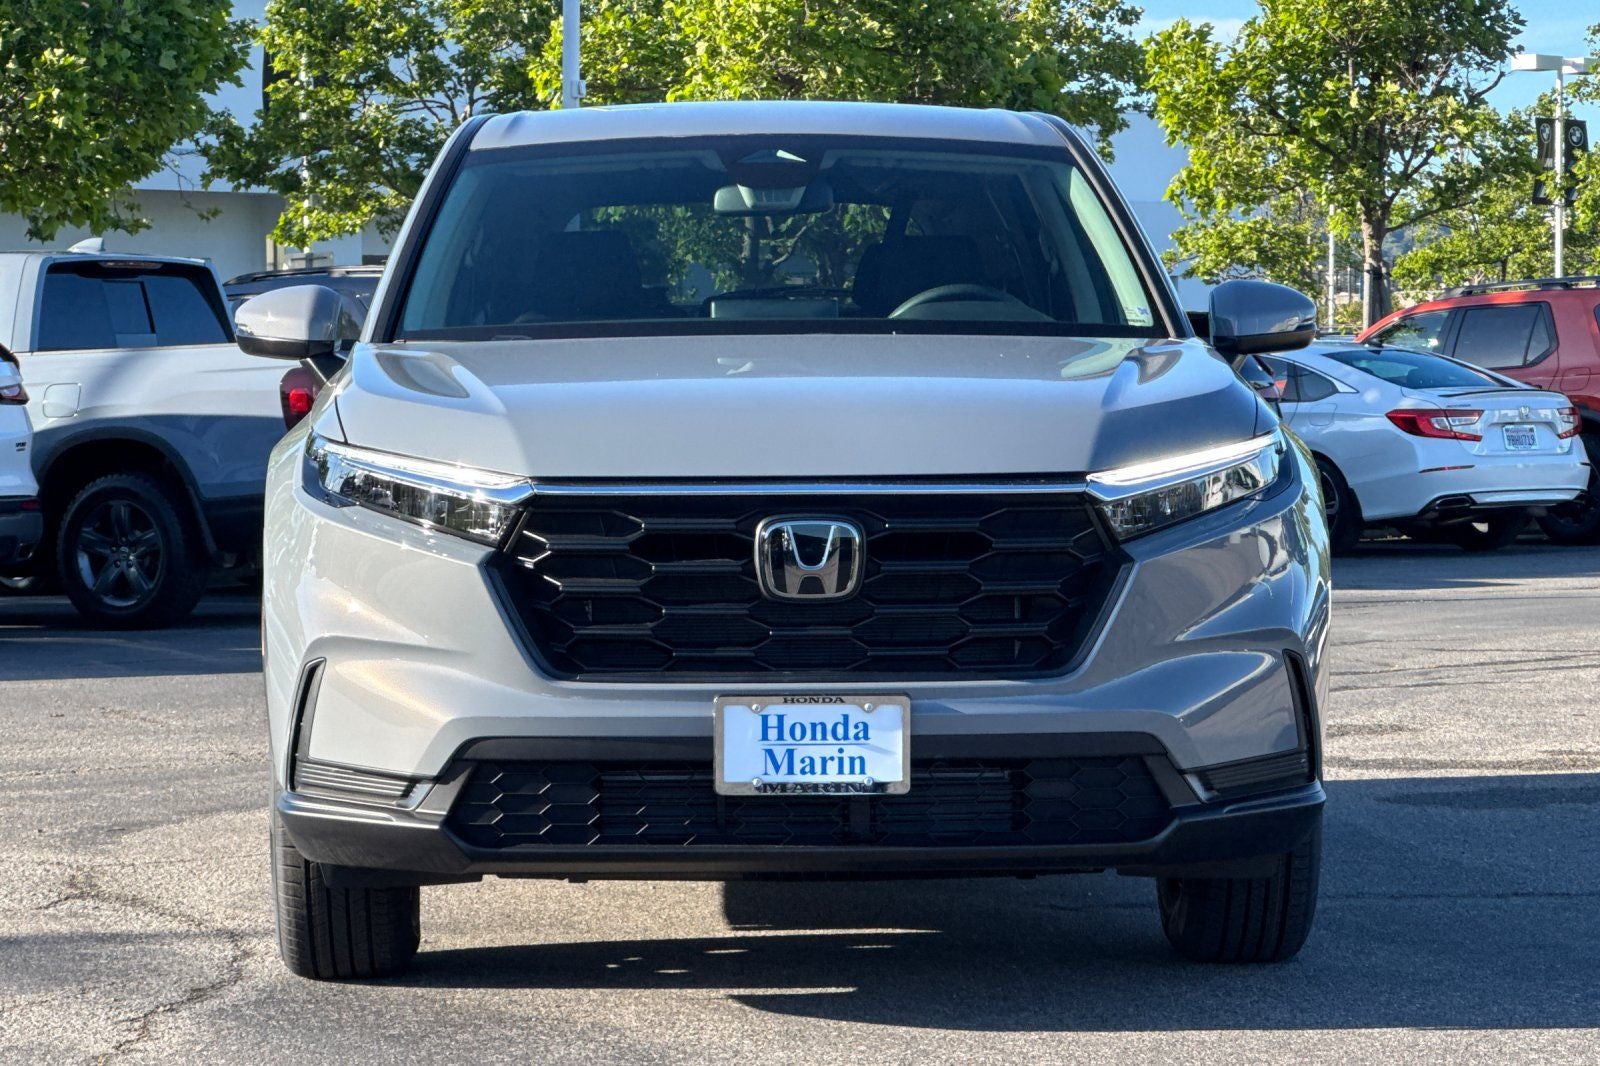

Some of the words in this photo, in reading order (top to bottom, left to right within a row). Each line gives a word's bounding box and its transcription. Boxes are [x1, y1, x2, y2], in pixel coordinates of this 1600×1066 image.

[758, 714, 871, 742] Honda
[762, 748, 867, 776] Marin
[762, 783, 865, 793] MARIN
